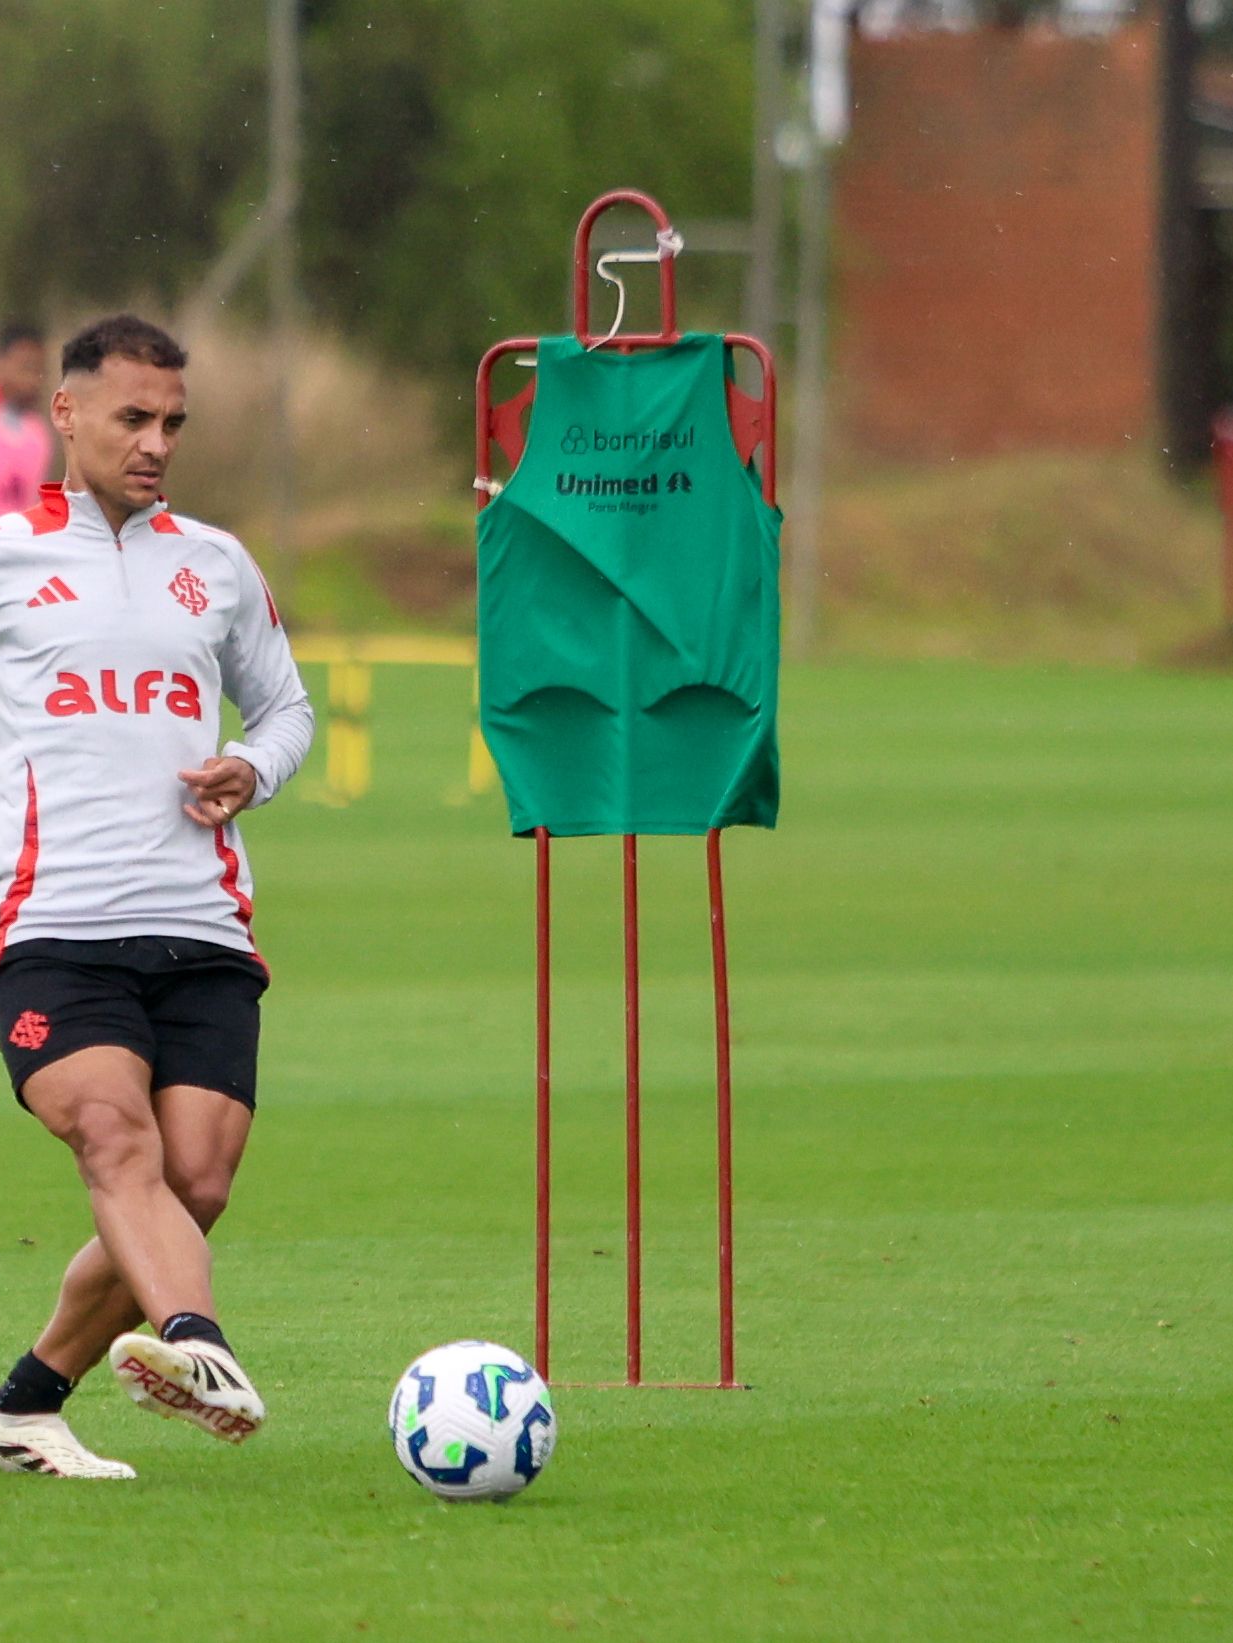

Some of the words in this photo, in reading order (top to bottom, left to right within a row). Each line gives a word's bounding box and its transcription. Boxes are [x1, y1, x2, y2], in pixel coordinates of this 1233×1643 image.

[594, 426, 694, 451] banrisul
[557, 473, 658, 495] Unimed
[44, 669, 202, 721] alfa
